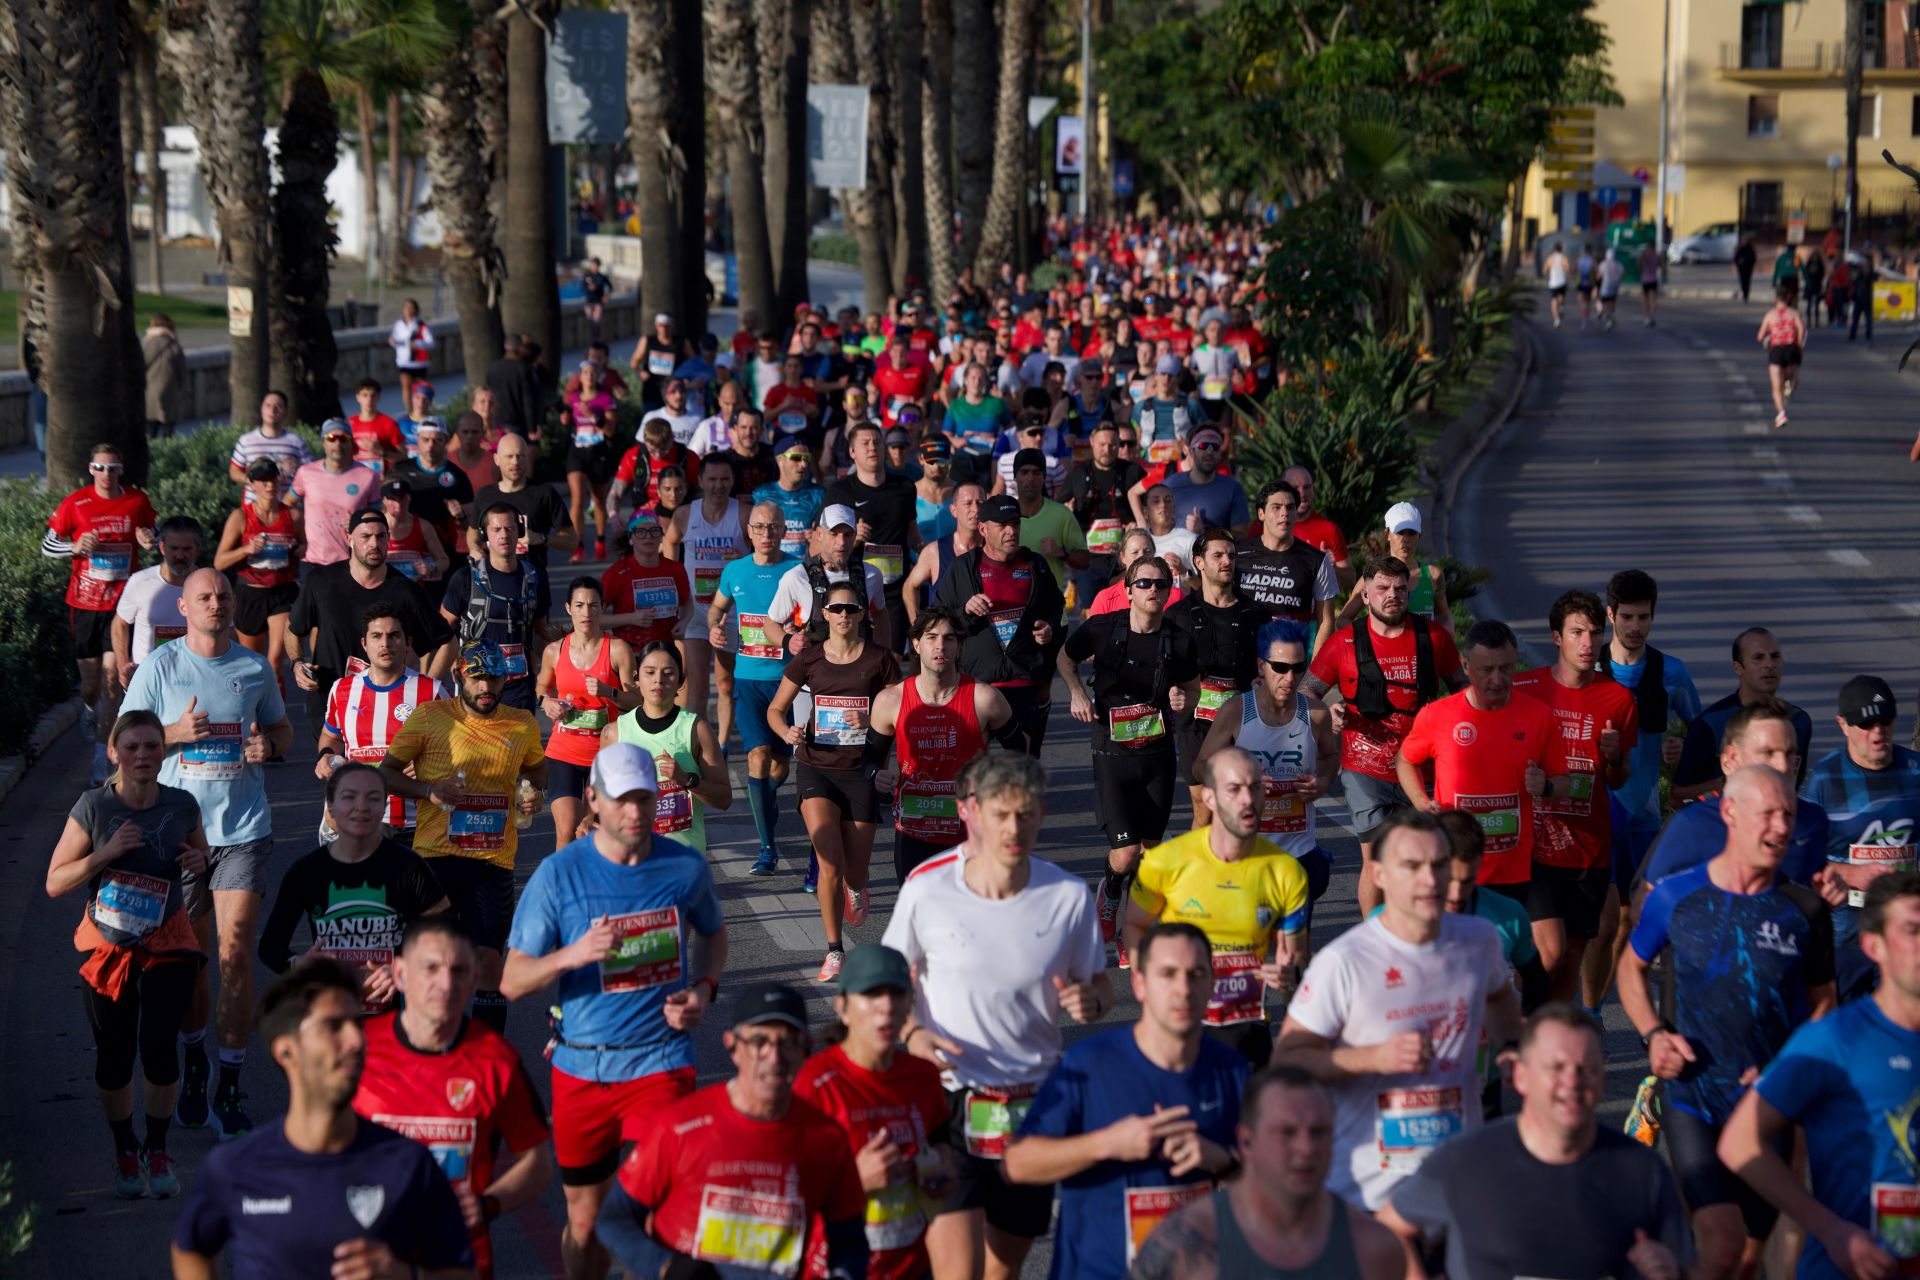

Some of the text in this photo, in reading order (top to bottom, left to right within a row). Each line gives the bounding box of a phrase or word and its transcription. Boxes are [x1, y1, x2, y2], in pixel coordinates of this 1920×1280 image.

[786, 519, 805, 529] EDIA
[695, 537, 733, 548] ITALIA
[1240, 572, 1295, 589] MADRID
[645, 591, 671, 602] 13715
[749, 629, 765, 638] 375
[830, 699, 865, 707] GENERALI
[827, 712, 845, 723] 106
[1562, 727, 1580, 739] AGA
[918, 738, 947, 748] MÁLAGA
[193, 743, 231, 755] 14268
[363, 749, 387, 757] GENE
[1286, 766, 1304, 774] RUN
[469, 797, 505, 806] GENERALI
[916, 798, 945, 810] 2094
[1472, 797, 1515, 808] GENERALI
[466, 814, 494, 825] 2533
[1480, 816, 1504, 828] 368
[121, 875, 165, 892] GENERALI
[111, 888, 150, 910] 12981
[315, 914, 398, 936] DANUBE
[338, 951, 387, 961] GENERALI
[399, 1123, 468, 1140] GENERALI
